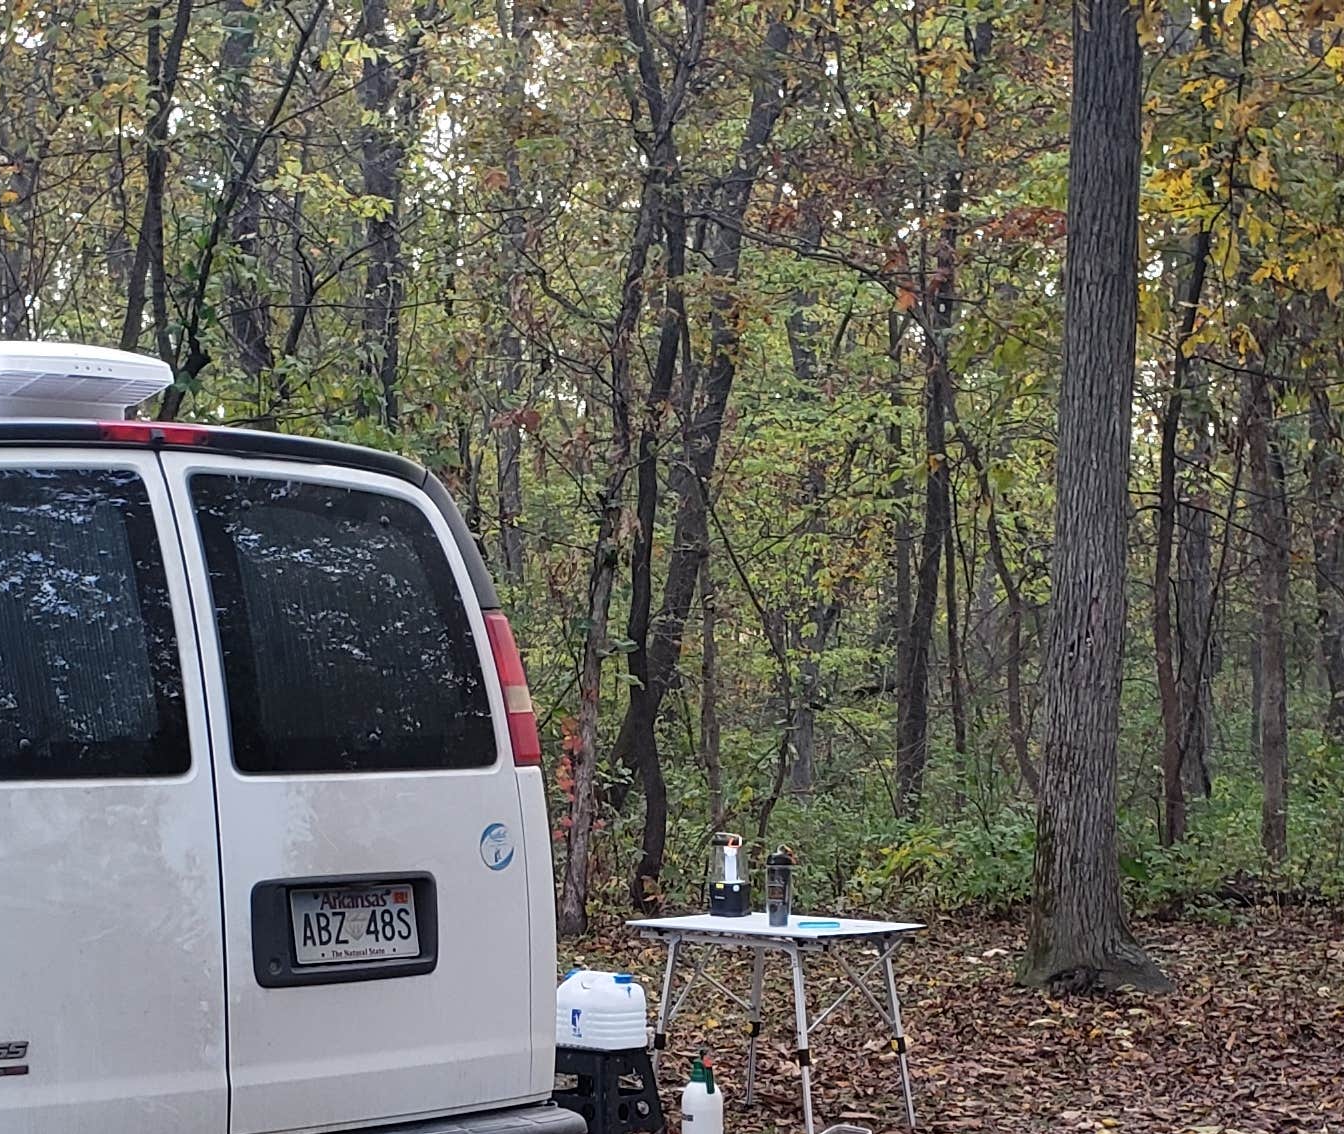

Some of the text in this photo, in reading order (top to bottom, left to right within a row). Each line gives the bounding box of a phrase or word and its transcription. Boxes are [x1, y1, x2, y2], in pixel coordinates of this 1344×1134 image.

[320, 890, 387, 911] Arkansas
[303, 908, 411, 947] ABZ 48S
[332, 947, 386, 959] The Natural State
